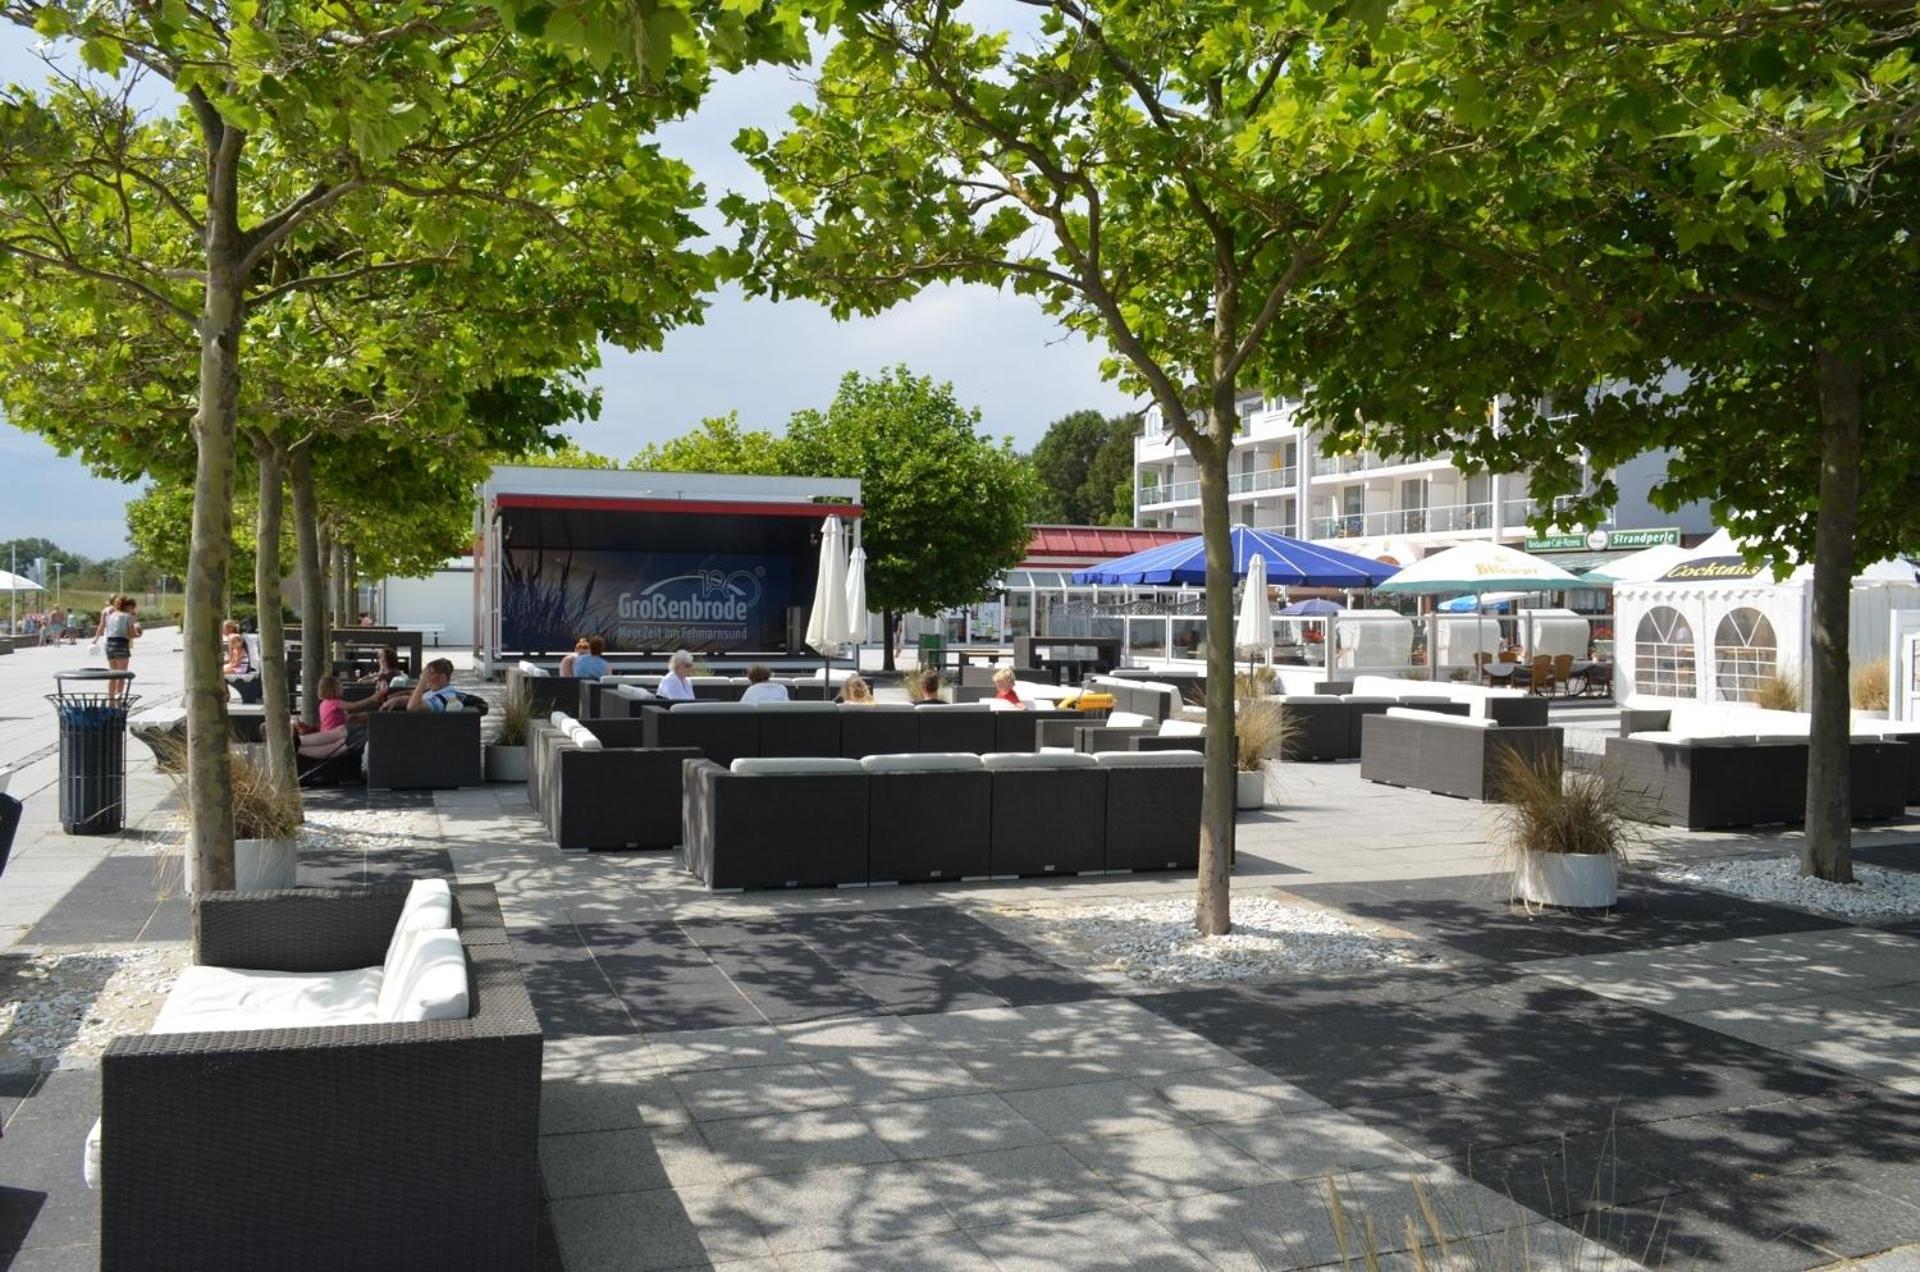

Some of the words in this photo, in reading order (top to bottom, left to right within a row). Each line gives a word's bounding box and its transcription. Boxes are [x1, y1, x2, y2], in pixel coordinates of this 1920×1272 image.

[1613, 530, 1675, 545] Strandperle
[618, 592, 747, 620] Großenbrode
[681, 626, 747, 641] Fehmarnsund
